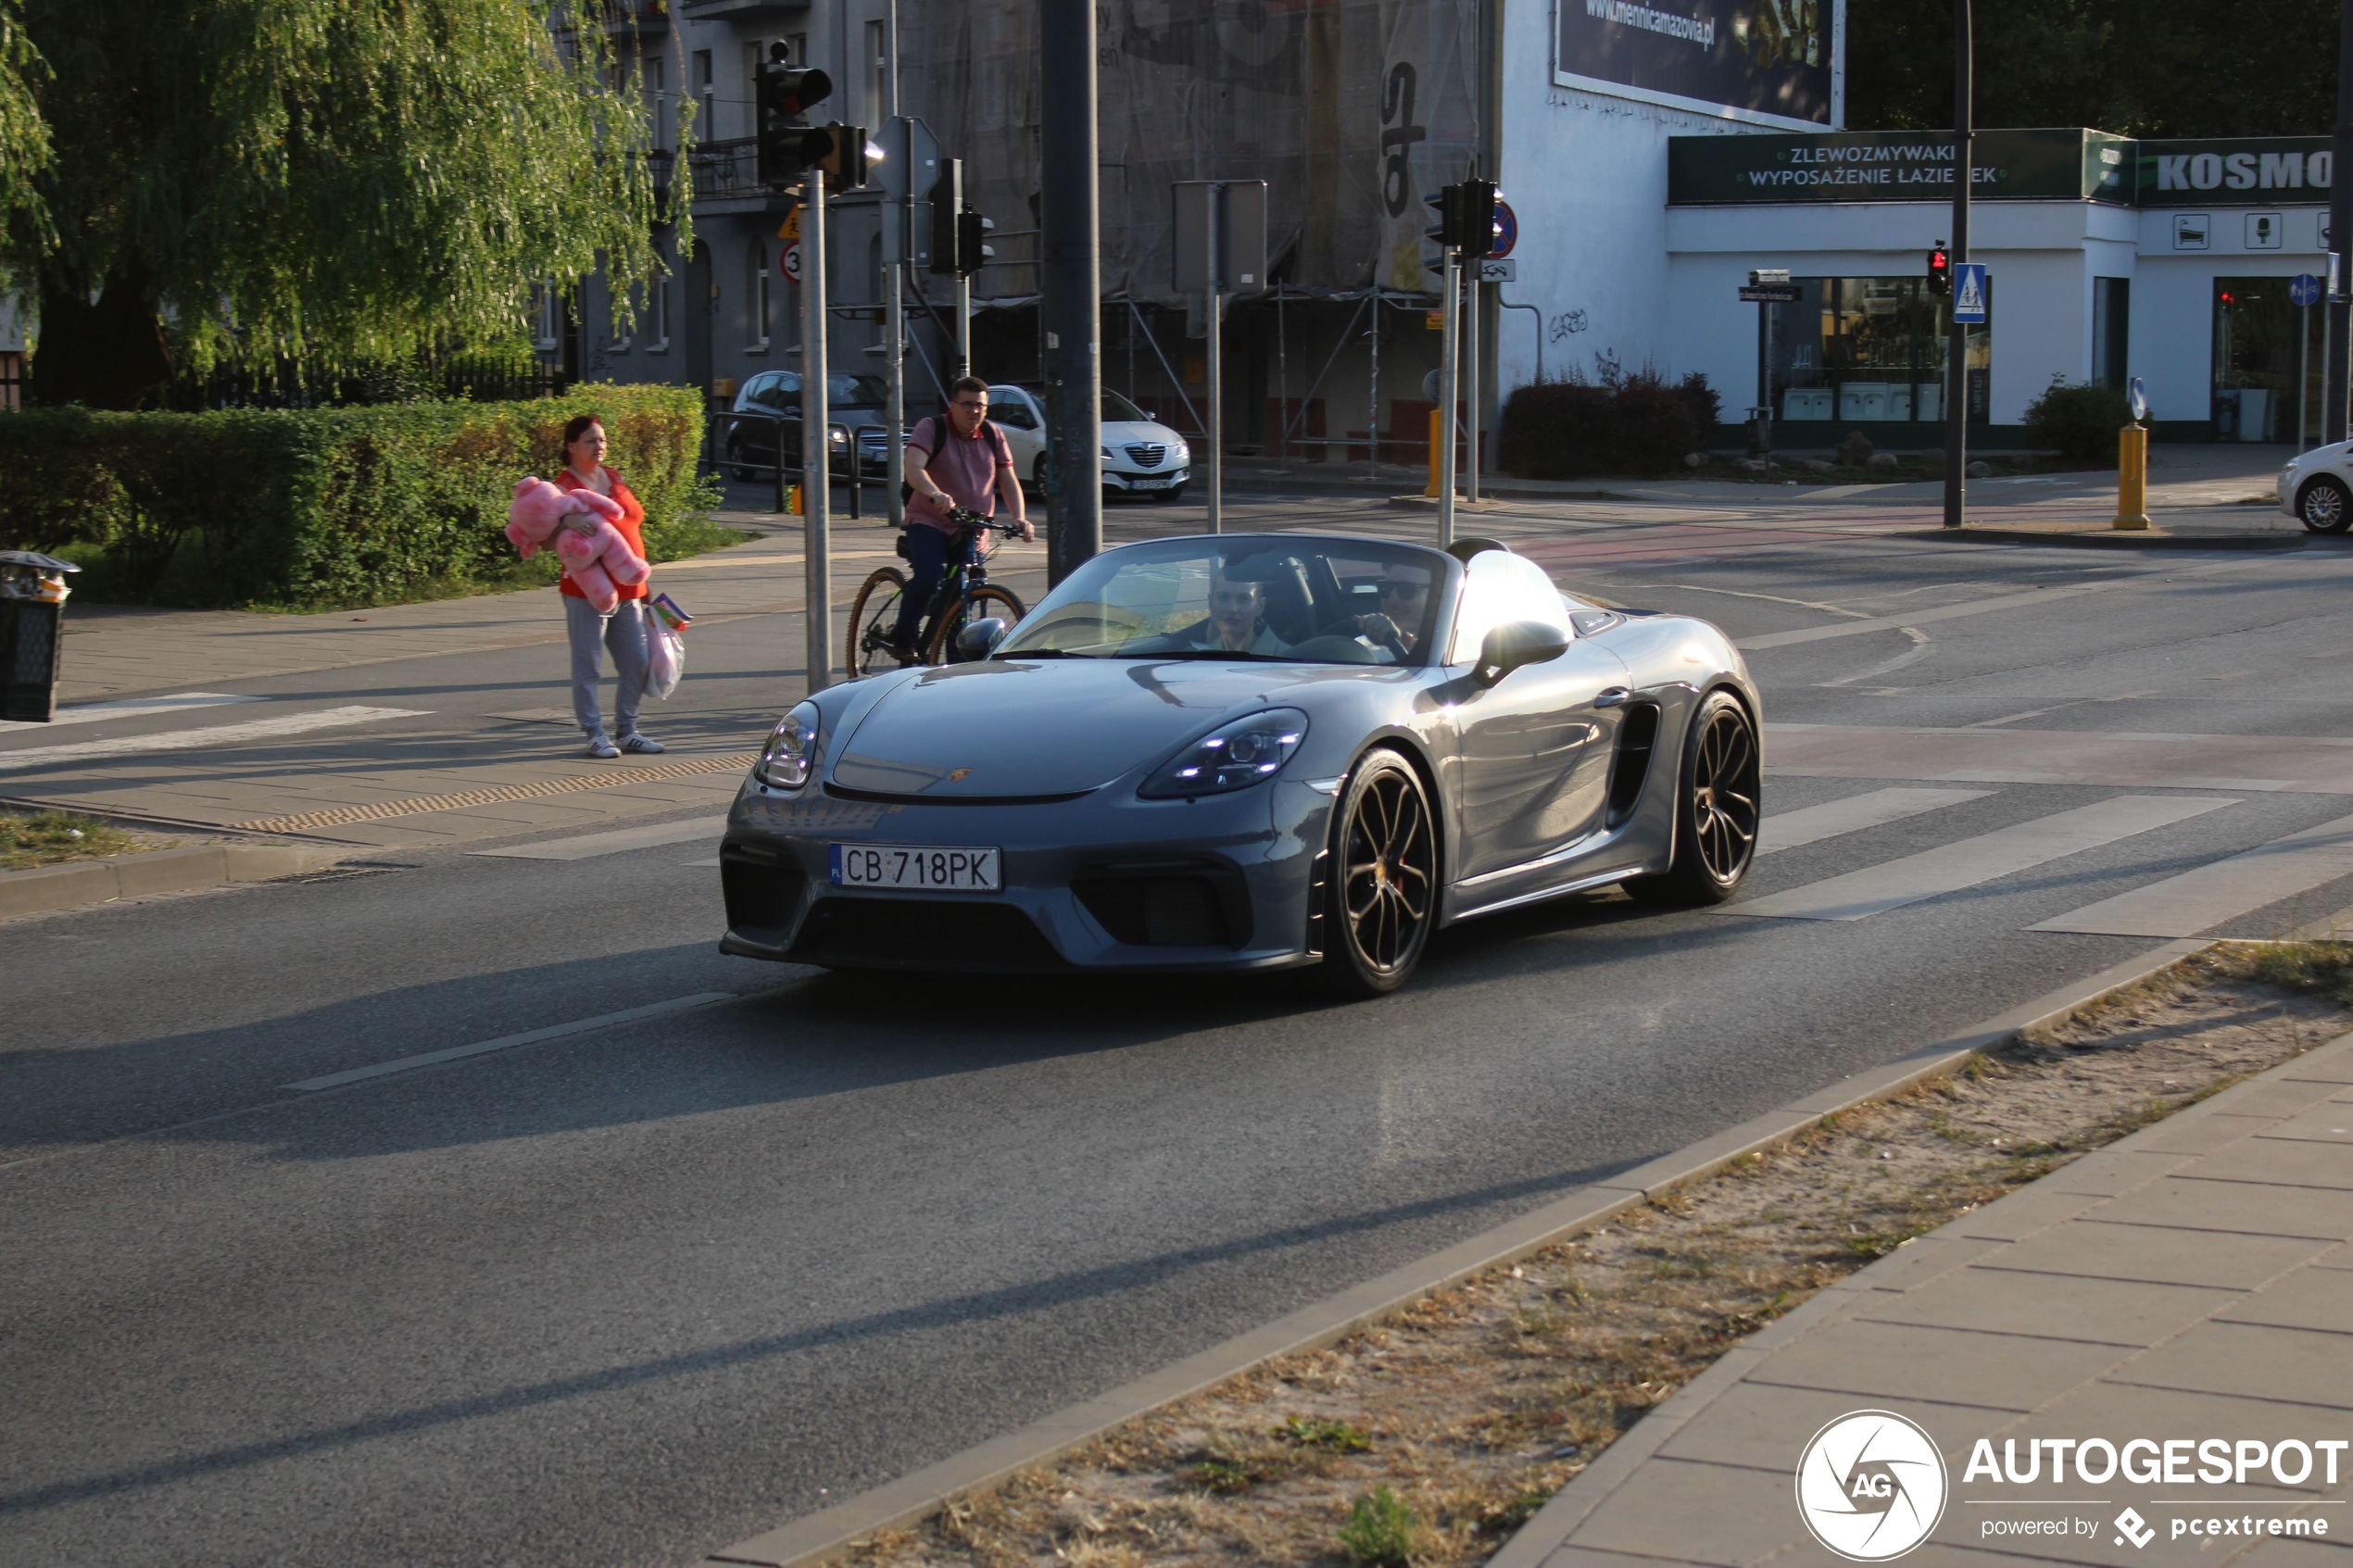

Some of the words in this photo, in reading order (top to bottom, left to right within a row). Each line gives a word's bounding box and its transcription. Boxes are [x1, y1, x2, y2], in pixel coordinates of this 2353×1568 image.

[1586, 0, 1714, 52] www.mennicamazovia.pl
[1791, 145, 1956, 163] ZLEWOZMYWAKI
[1749, 166, 1891, 186] WYPOSAŻENIE
[1898, 168, 1996, 184] ŁAZIEEK
[2158, 151, 2333, 191] KOSMO
[786, 251, 800, 273] 3
[831, 869, 840, 878] PL
[847, 849, 882, 883] CB
[893, 851, 989, 885] 718PK
